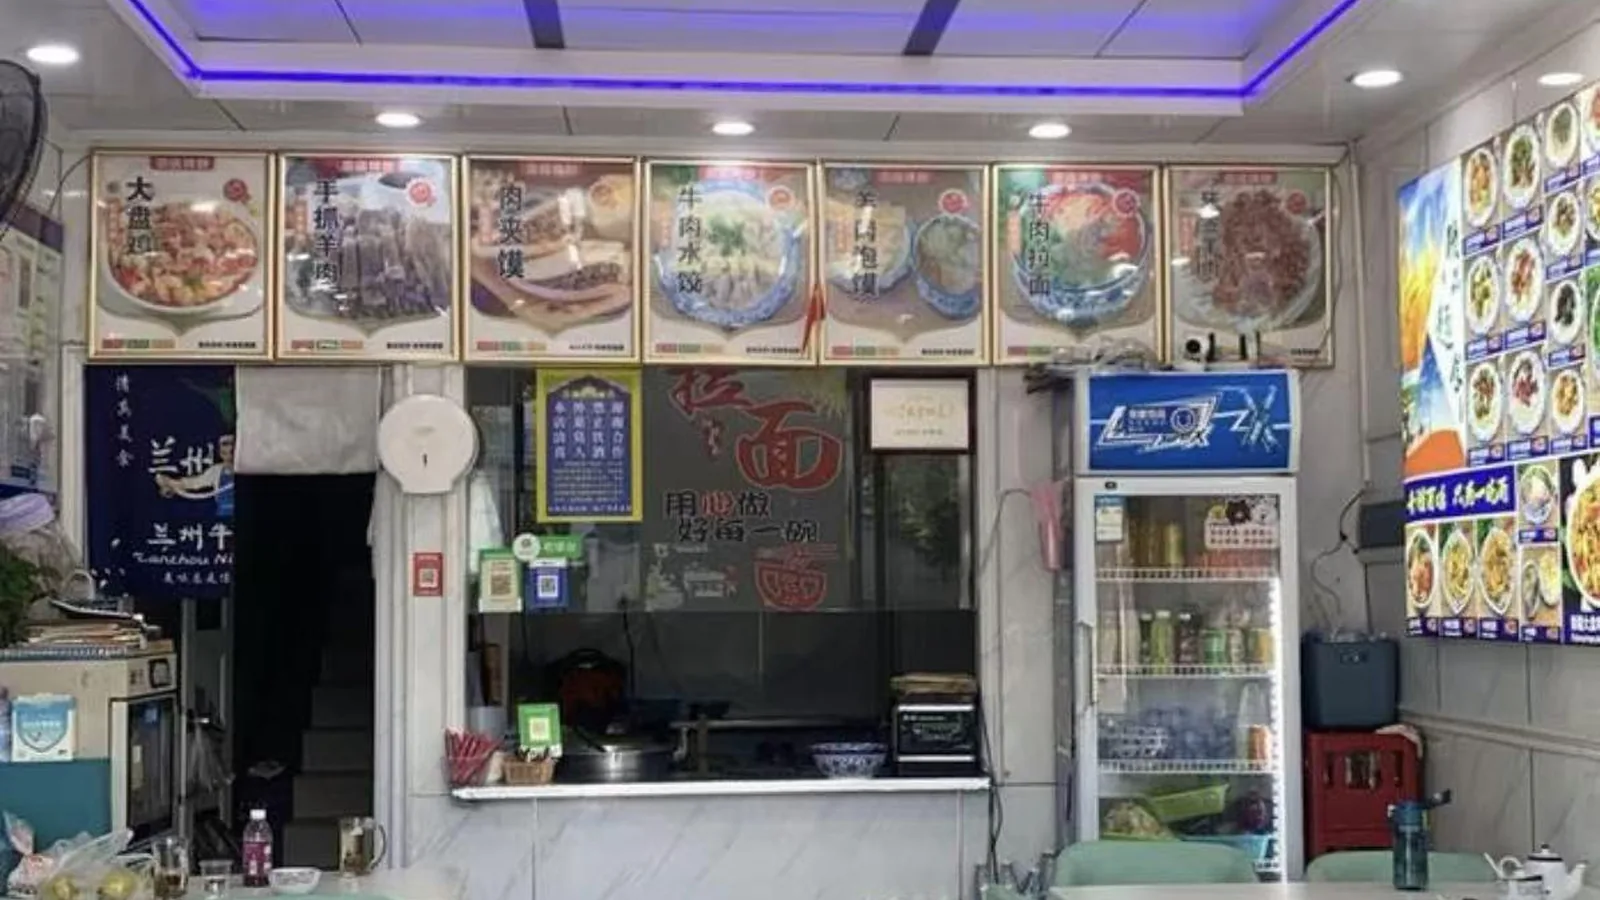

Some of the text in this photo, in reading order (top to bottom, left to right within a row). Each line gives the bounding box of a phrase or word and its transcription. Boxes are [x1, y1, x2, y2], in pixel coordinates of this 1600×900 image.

[126, 176, 154, 254] 大盘鸡
[313, 179, 342, 285] 手抓羊肉
[498, 185, 525, 280] 肉夹馍
[677, 187, 703, 295] 牛肉水饺
[148, 435, 215, 477] 兰州
[147, 521, 233, 551] 兰州牛
[666, 491, 770, 517] 用心做
